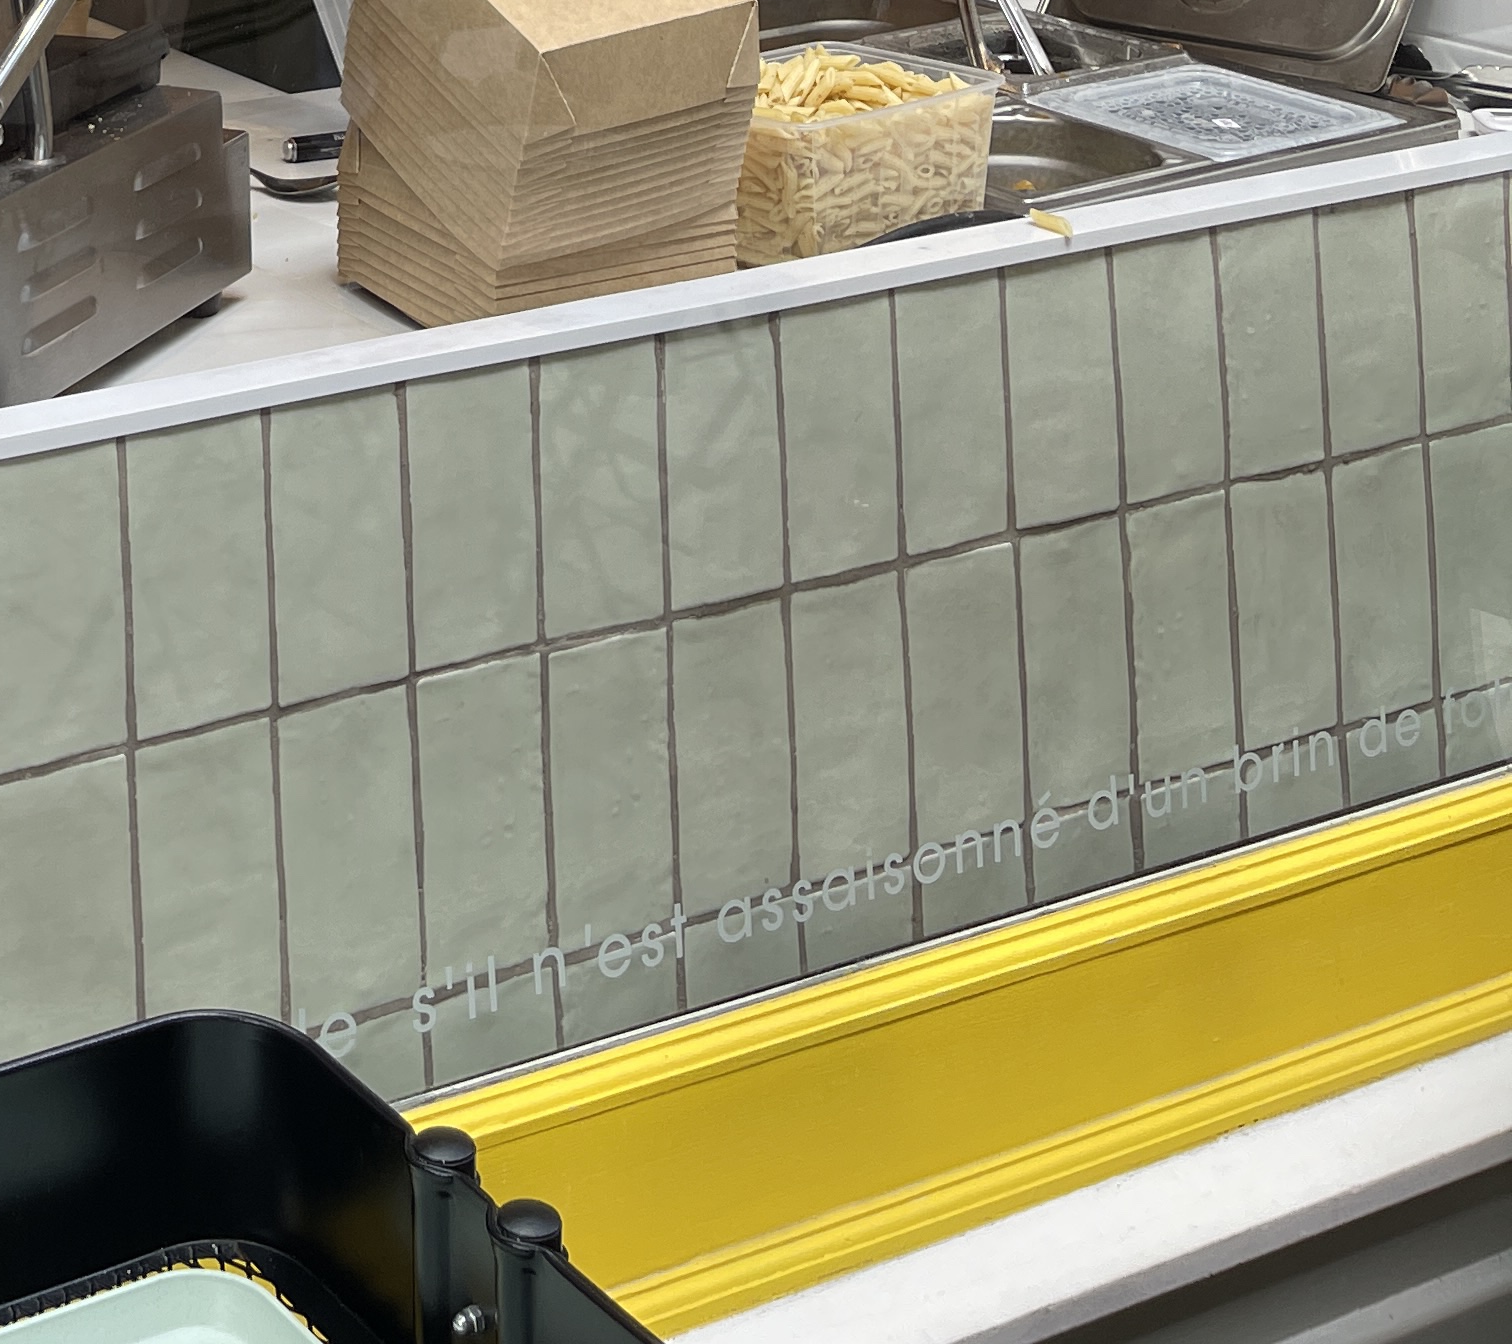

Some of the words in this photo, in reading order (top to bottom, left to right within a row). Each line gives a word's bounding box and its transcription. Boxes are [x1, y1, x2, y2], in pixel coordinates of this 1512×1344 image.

[411, 954, 499, 1034] s'il
[531, 902, 690, 995] n'est
[716, 791, 1063, 945] assaisonné
[1086, 772, 1209, 832] d'un
[1232, 727, 1338, 795] brin
[1358, 704, 1422, 759] de
